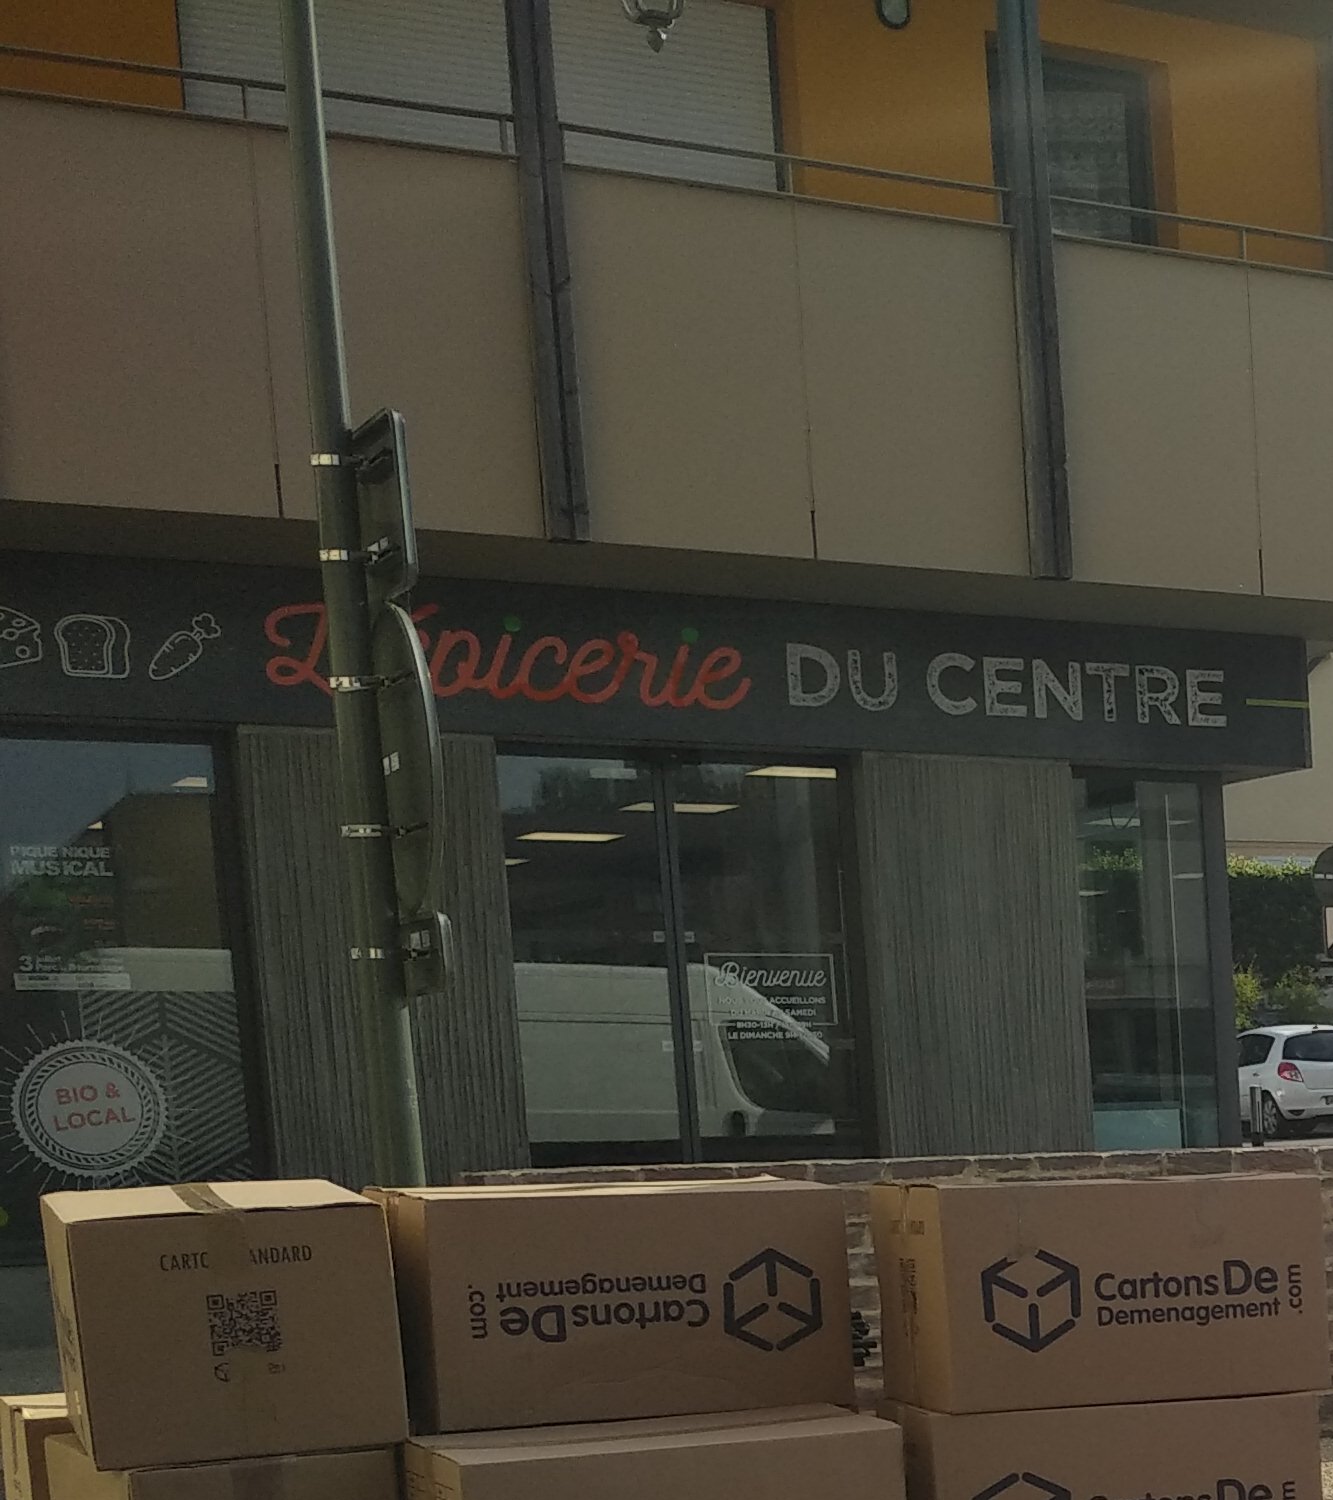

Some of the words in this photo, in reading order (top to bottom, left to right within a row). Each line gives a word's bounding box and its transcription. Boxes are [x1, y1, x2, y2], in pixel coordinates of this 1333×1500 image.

[264, 601, 751, 709] Lpicerie
[785, 642, 897, 711] DU
[926, 652, 1228, 727] CENTRE
[10, 846, 58, 858] PIQUE
[62, 846, 110, 859] NIQUE
[11, 860, 114, 877] MUSICAL
[18, 955, 33, 972] 3
[715, 961, 827, 988] Bienvenue
[785, 1008, 817, 1016] SAMEDI
[728, 1032, 738, 1040] LE
[740, 1031, 784, 1040] DIMANCHE
[55, 1085, 97, 1105] BIO
[105, 1082, 120, 1099] &
[53, 1106, 136, 1132] LOCAL
[495, 1271, 707, 1304] Demenagement
[1286, 1263, 1304, 1315] .com
[1096, 1296, 1282, 1328] Demenagement
